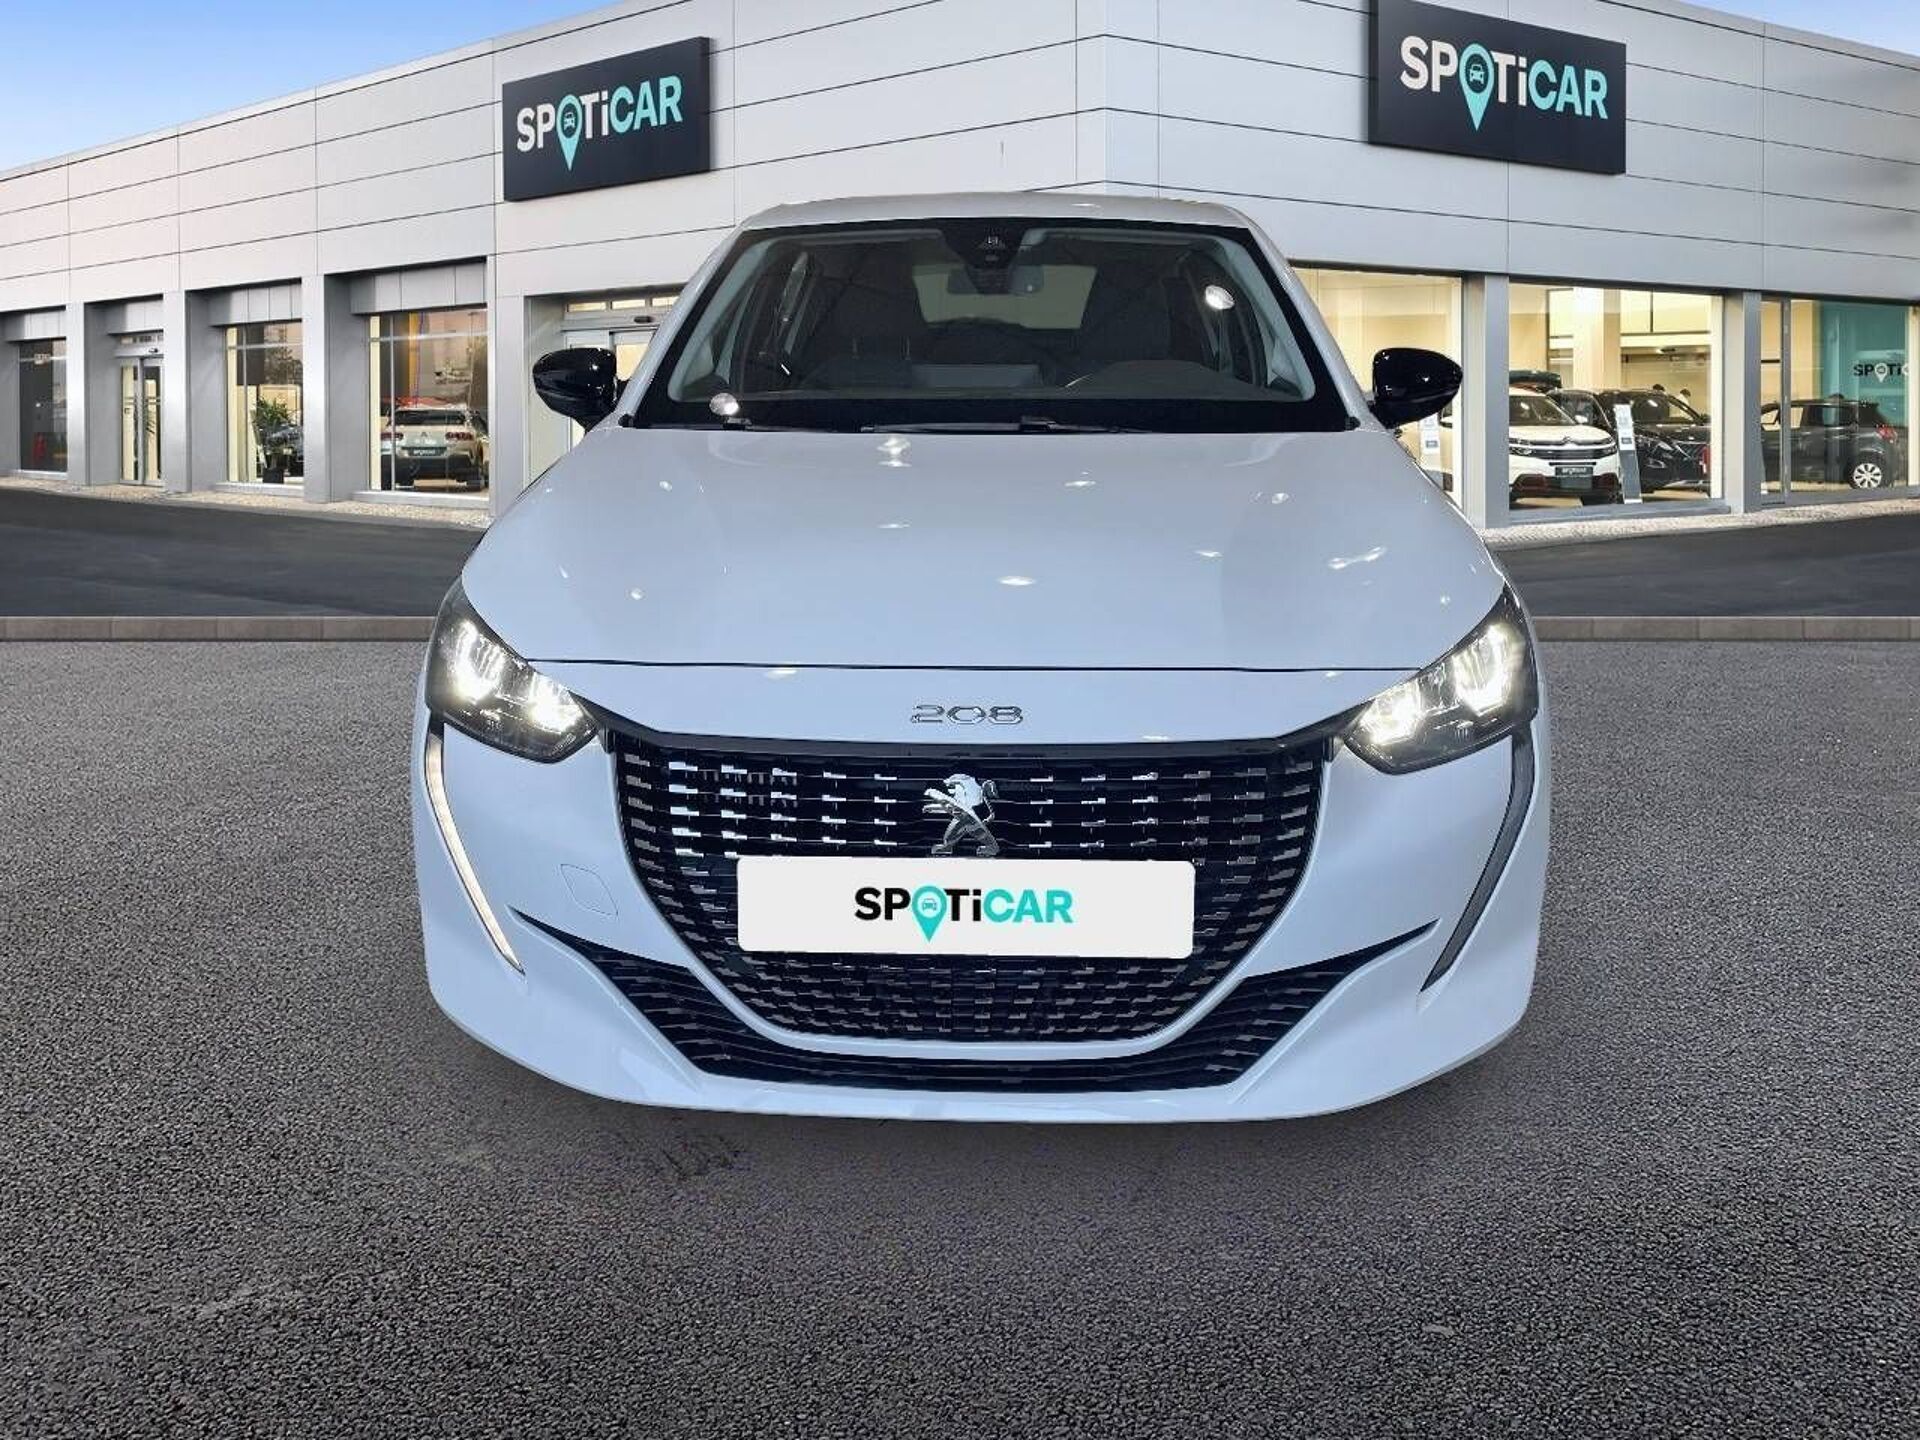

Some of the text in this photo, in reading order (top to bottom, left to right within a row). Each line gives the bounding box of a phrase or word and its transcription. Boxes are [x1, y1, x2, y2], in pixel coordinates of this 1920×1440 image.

[1400, 35, 1608, 131] SPOTiCAR
[516, 75, 683, 171] SPOTiCAR
[910, 704, 1023, 725] 208
[854, 885, 1073, 942] SPOTiCAR
